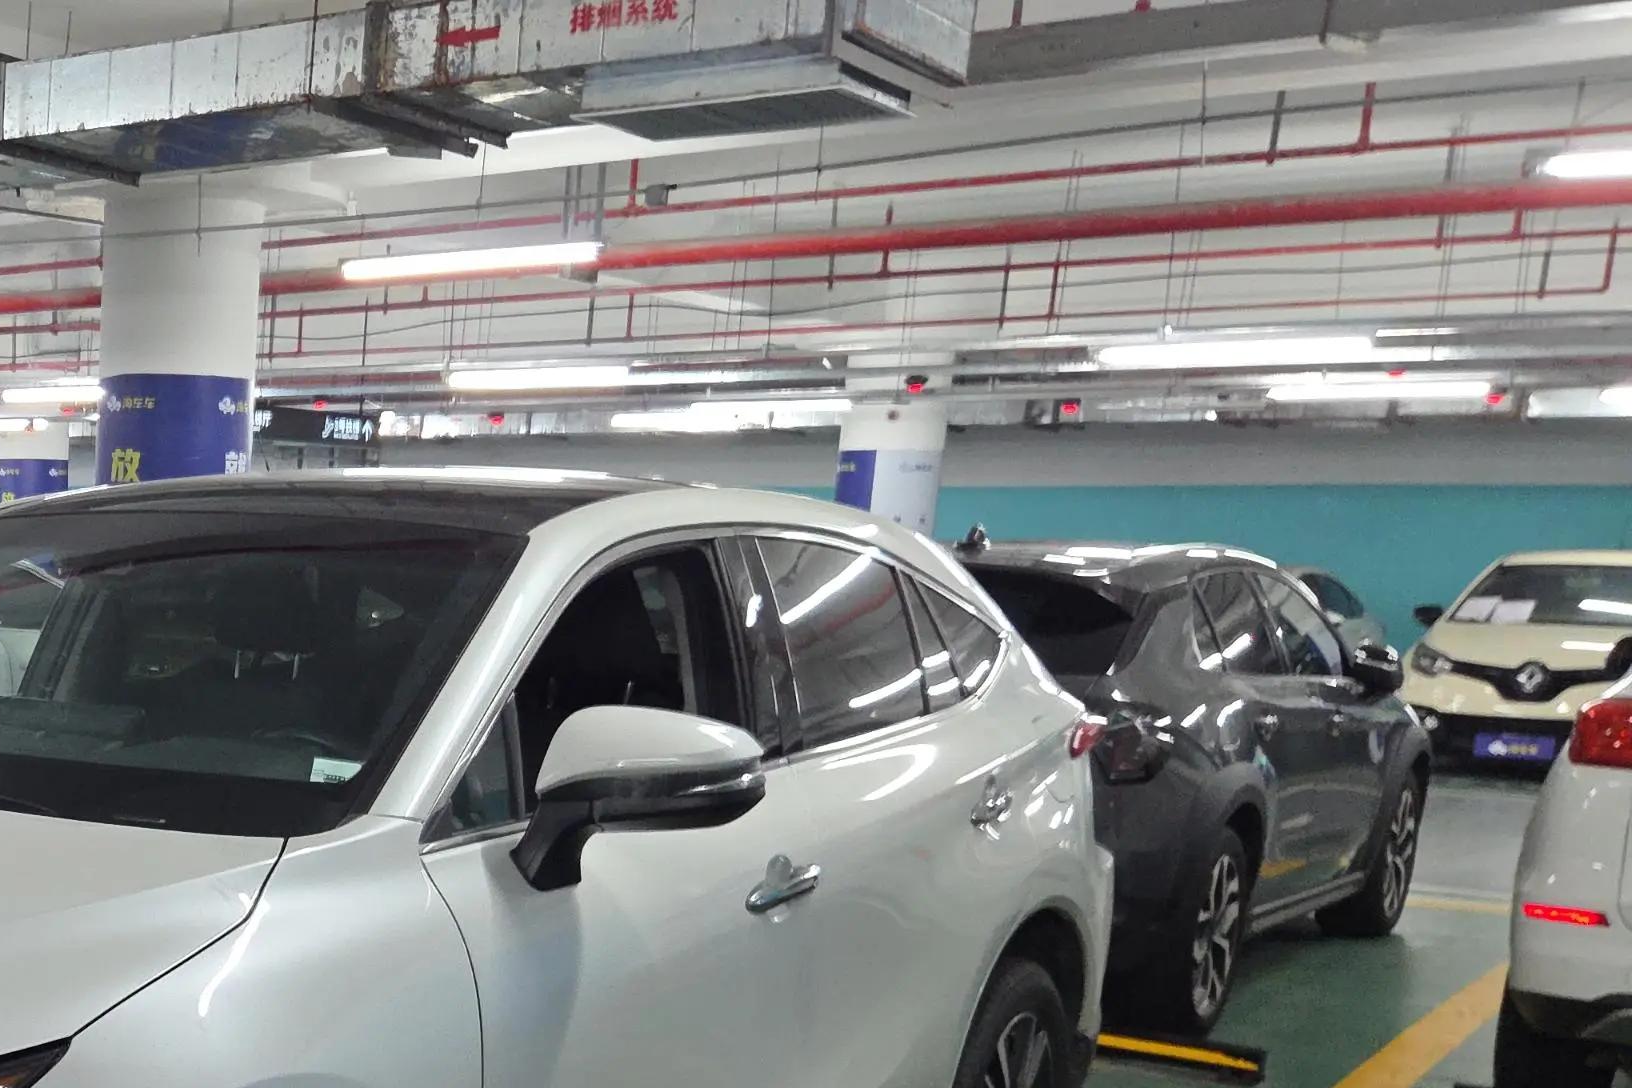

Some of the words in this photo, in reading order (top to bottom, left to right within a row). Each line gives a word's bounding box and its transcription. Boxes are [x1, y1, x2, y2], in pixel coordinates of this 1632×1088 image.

[570, 0, 678, 34] 排烟系统
[111, 448, 140, 483] 放
